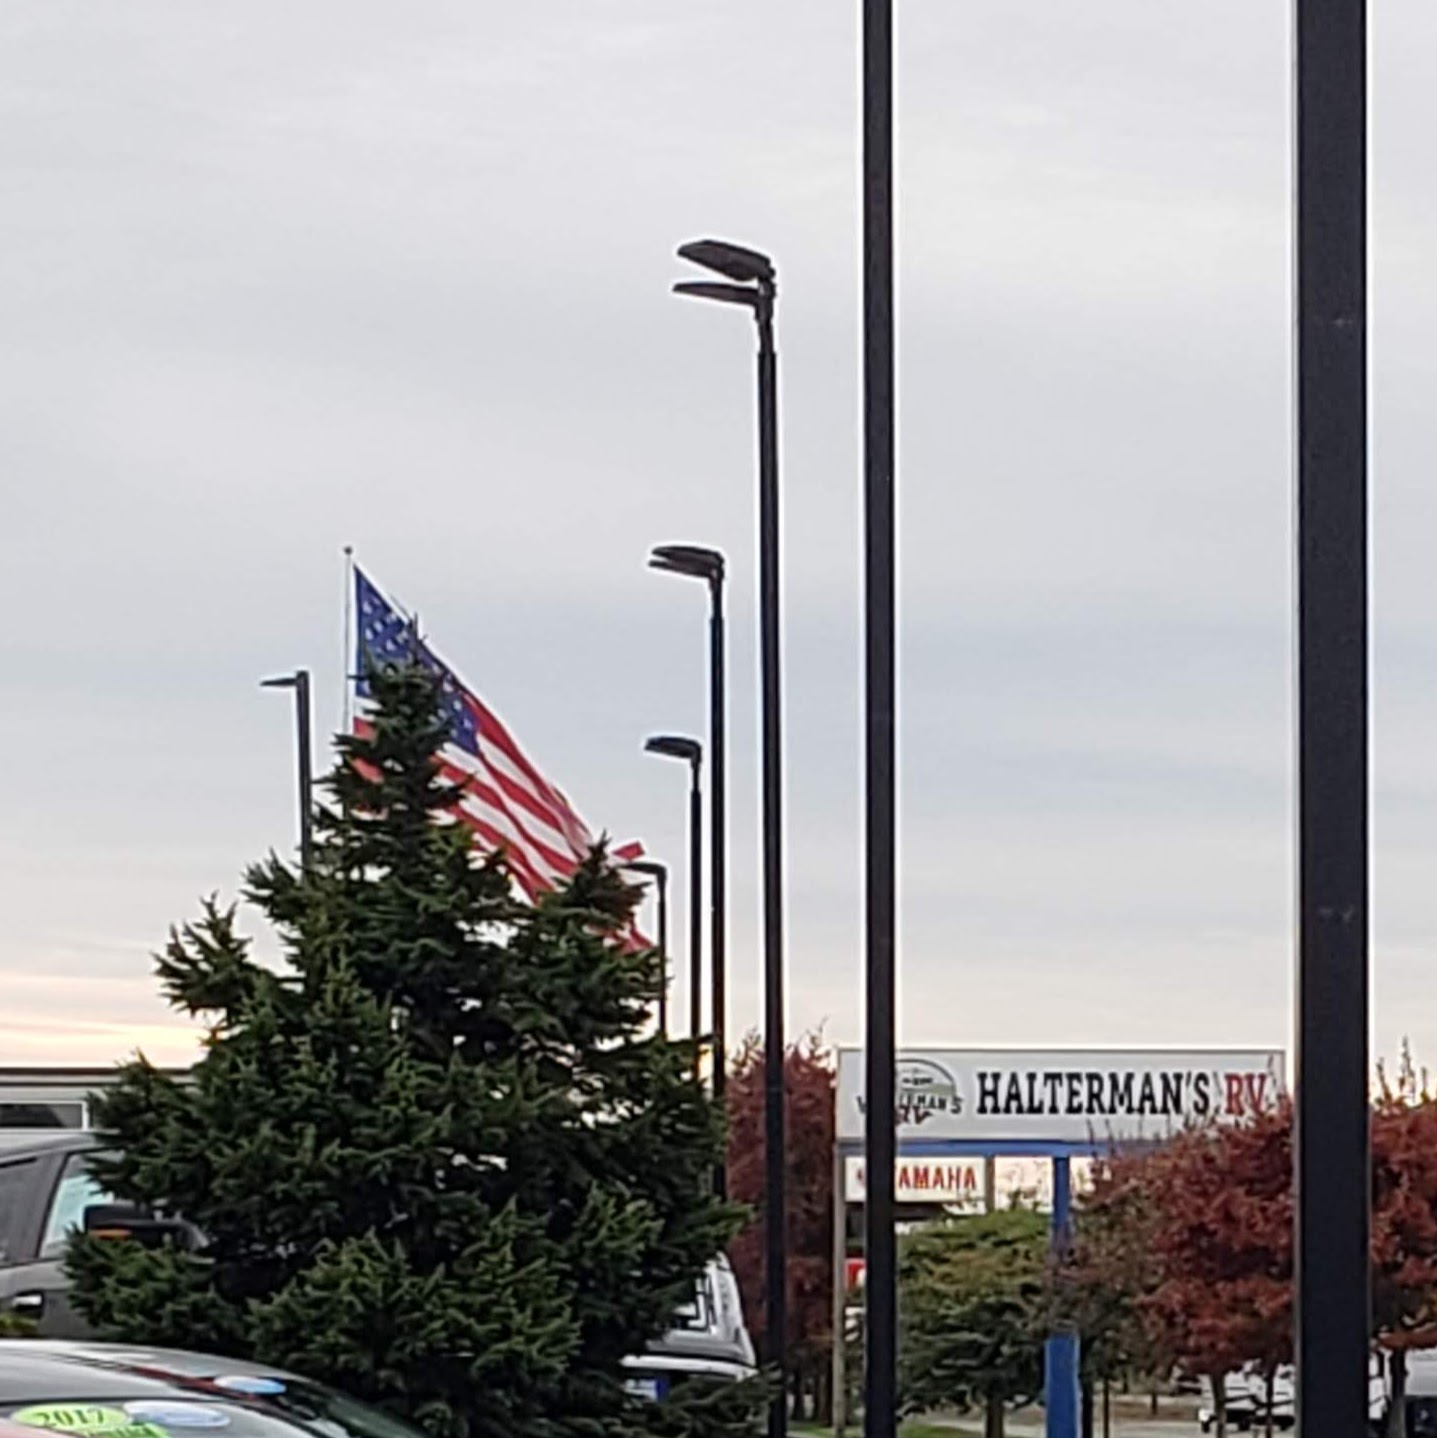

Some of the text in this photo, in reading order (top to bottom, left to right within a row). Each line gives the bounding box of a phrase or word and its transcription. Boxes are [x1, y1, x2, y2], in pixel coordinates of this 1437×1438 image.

[976, 1071, 1210, 1115] HALTERMAN'S
[1223, 1072, 1267, 1116] RV
[897, 1165, 976, 1190] AMAHA
[32, 1407, 106, 1428] 2017
